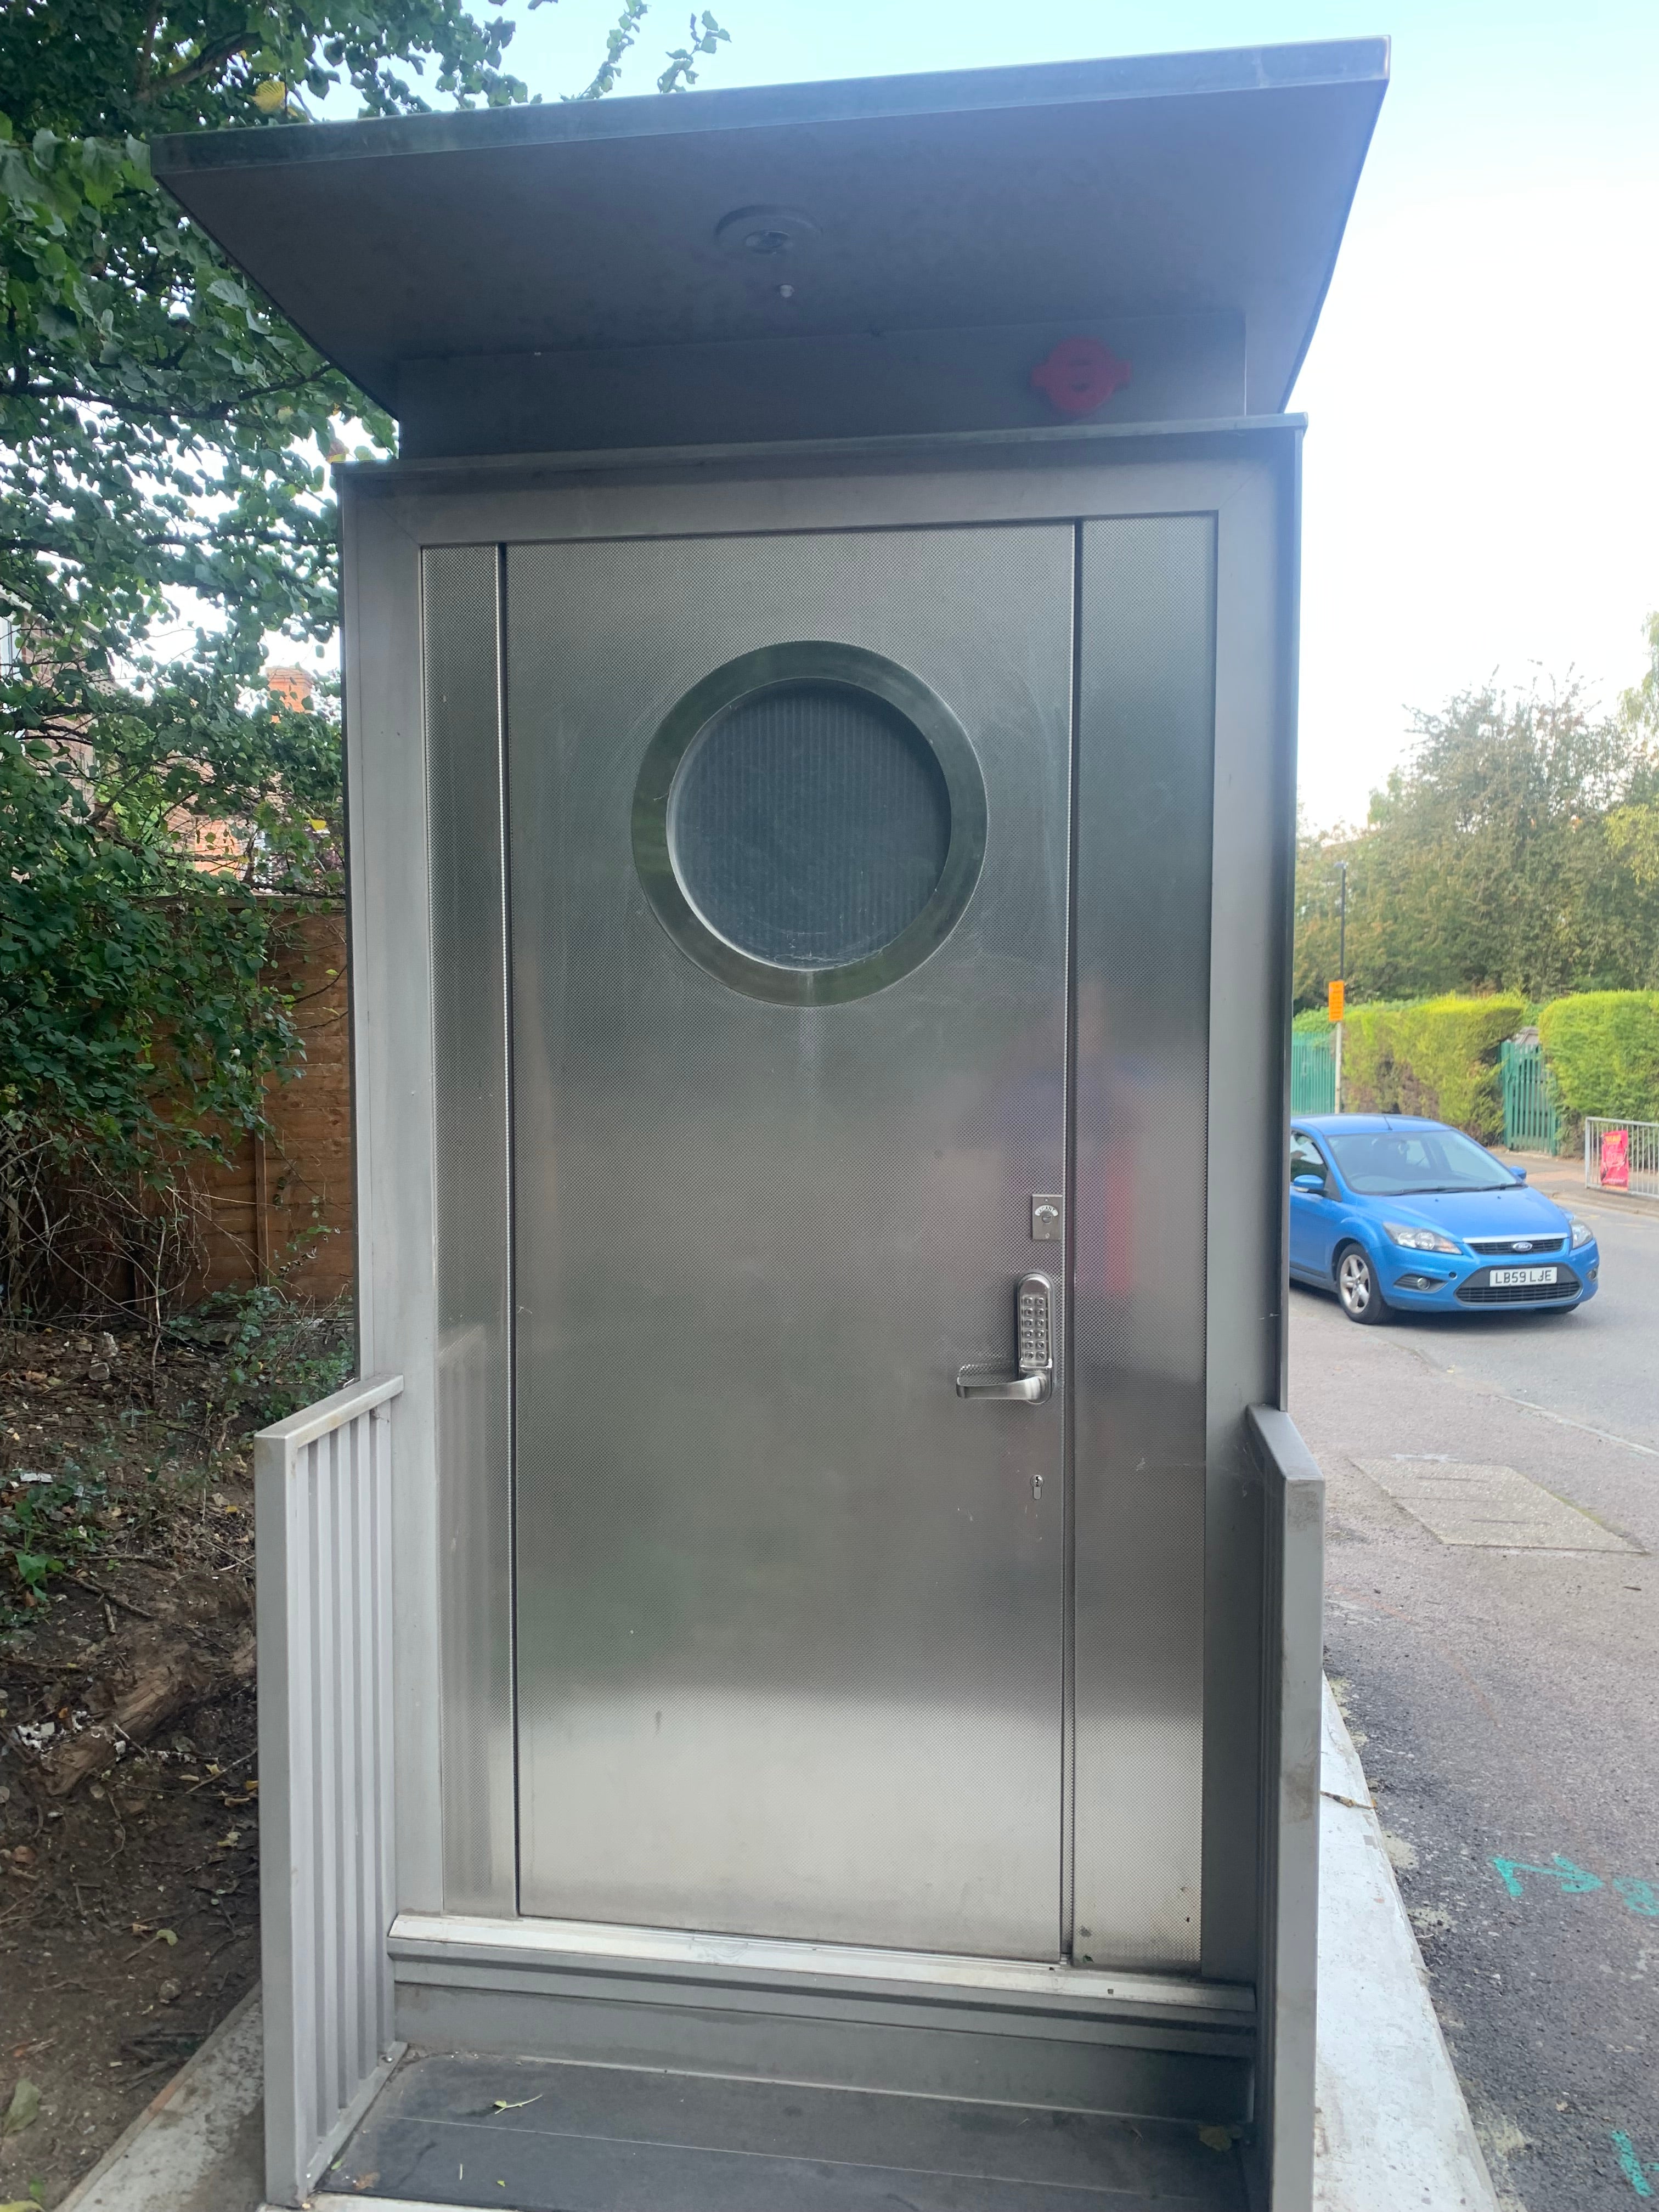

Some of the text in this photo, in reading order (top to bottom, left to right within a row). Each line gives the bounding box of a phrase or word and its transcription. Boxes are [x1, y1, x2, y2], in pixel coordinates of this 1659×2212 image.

[1036, 1206, 1056, 1215] VACANT
[1496, 1270, 1551, 1284] LB59 LJE
